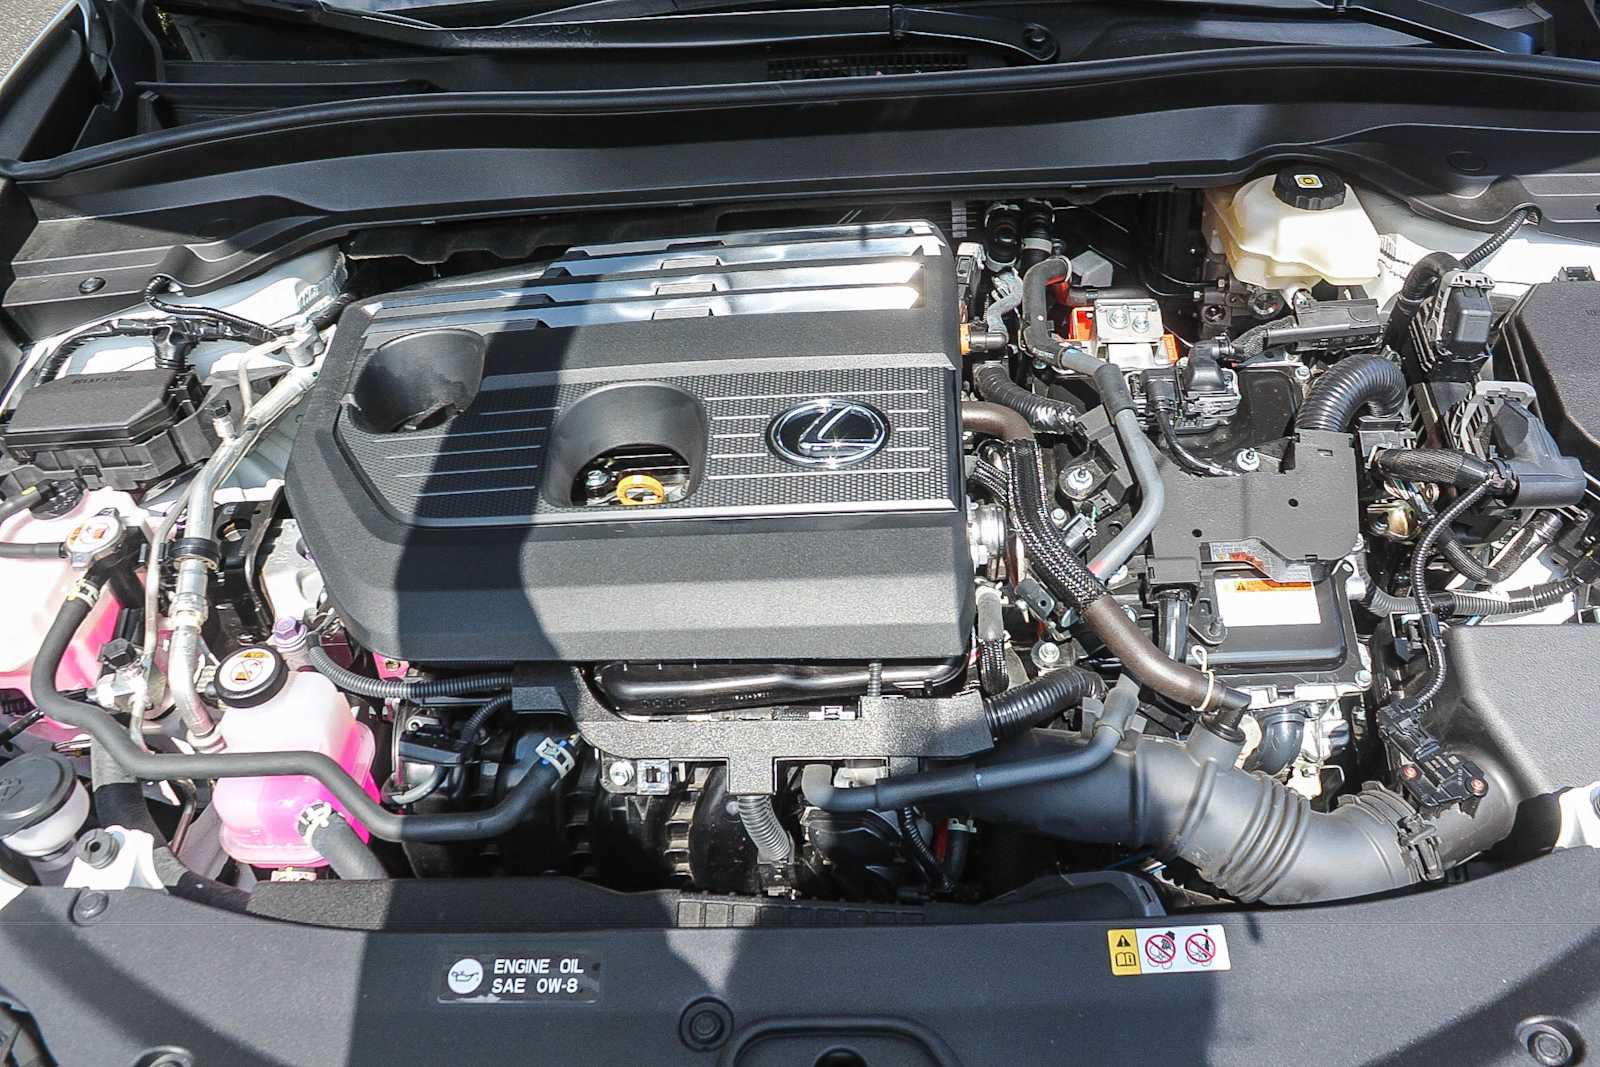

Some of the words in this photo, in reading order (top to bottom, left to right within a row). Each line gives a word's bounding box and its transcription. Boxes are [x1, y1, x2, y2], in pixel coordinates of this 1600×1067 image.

[493, 958, 551, 974] ENGINE
[559, 958, 585, 974] OIL
[491, 977, 527, 994] SAE
